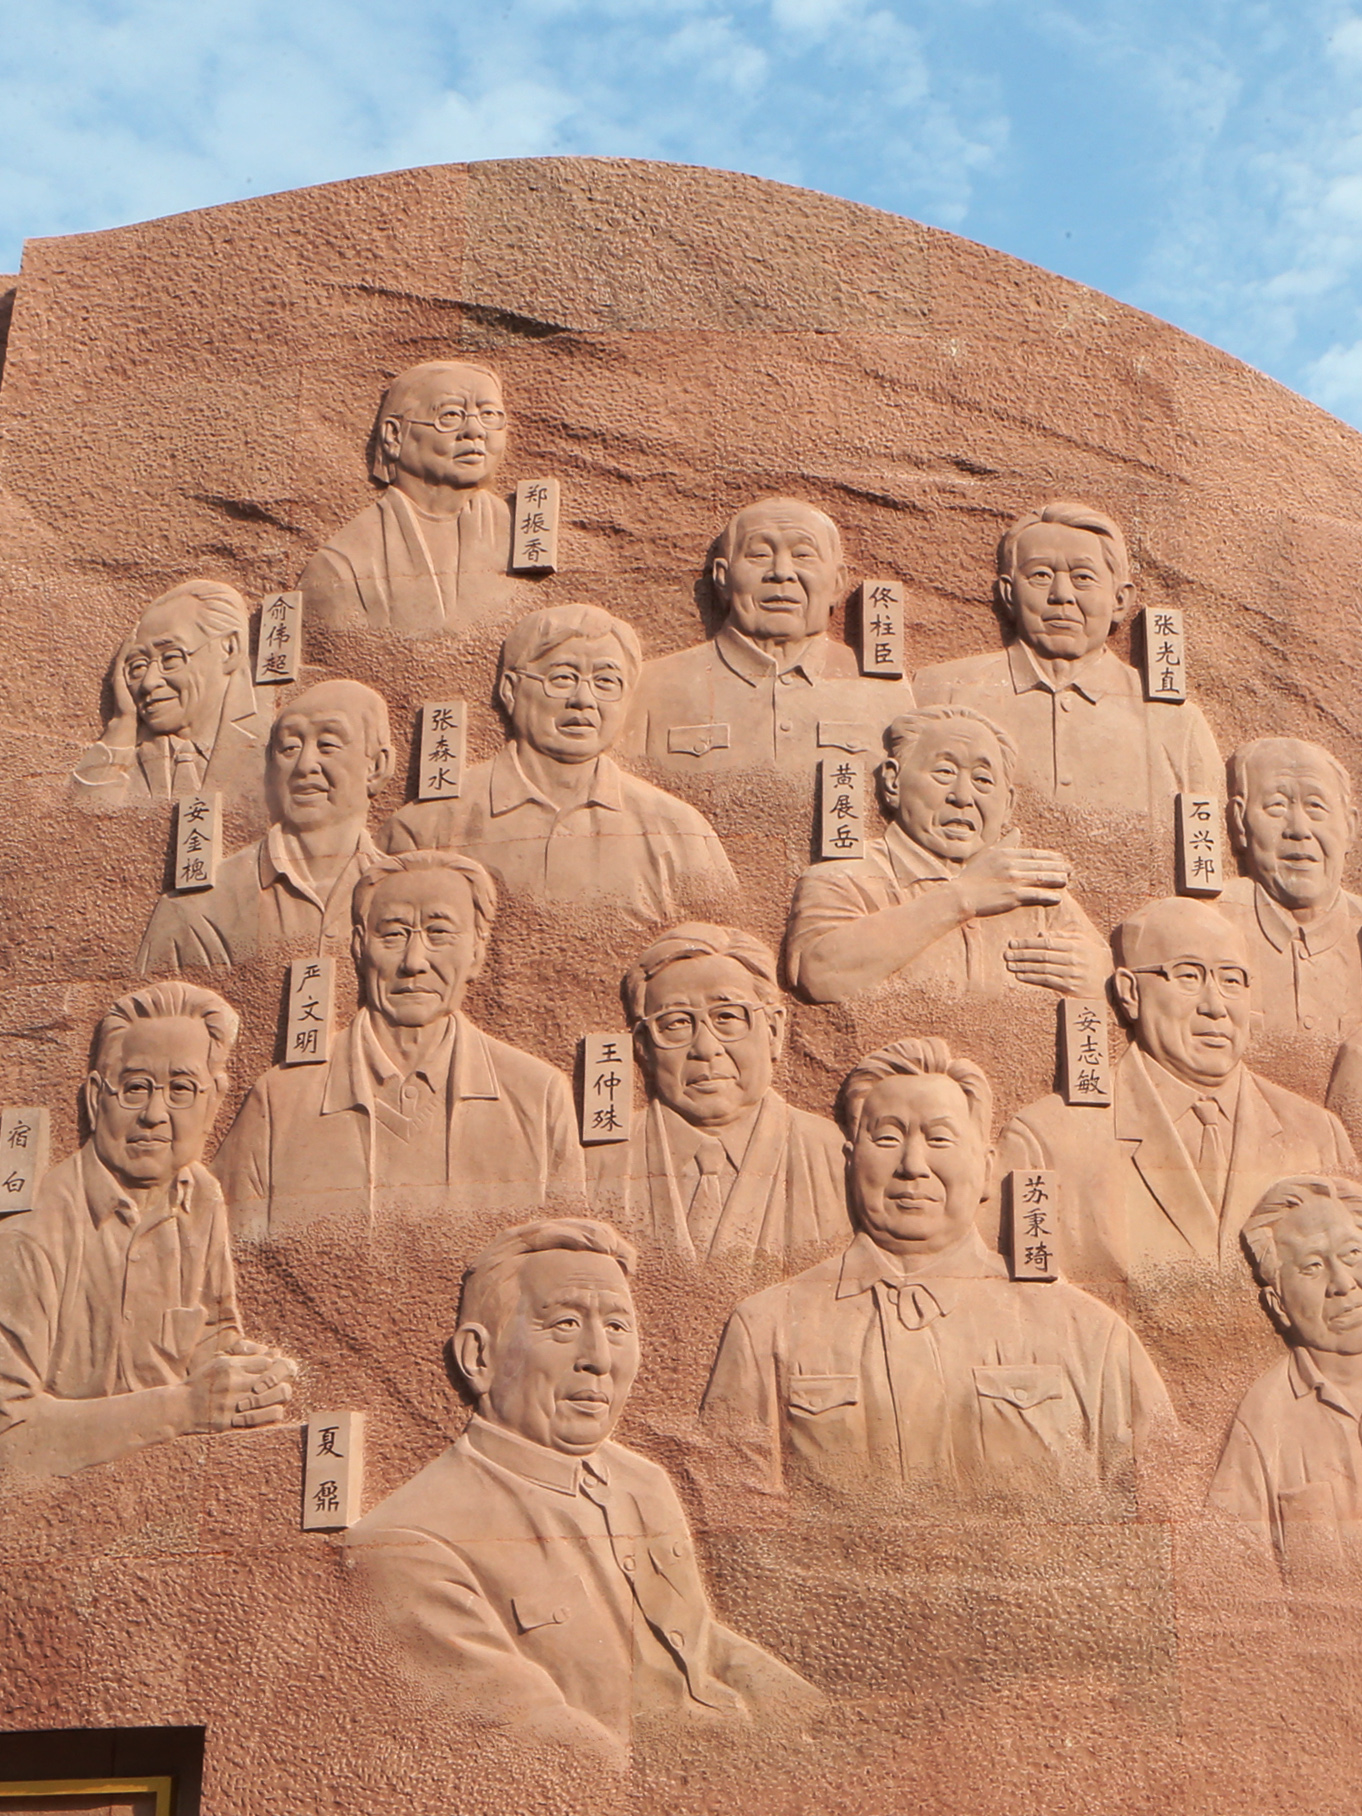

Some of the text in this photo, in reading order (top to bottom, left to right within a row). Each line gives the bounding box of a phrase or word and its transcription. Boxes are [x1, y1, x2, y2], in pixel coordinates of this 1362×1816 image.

[521, 484, 550, 563] 郑振香
[262, 596, 294, 676] 俞伟超
[869, 586, 898, 664] 佟柱臣
[1154, 614, 1180, 693] 张光直
[428, 709, 458, 790] 张森水
[180, 797, 211, 882] 安金槐
[829, 763, 859, 849] 黄展岳
[1189, 801, 1215, 883] 石兴邦
[293, 964, 324, 1053] 严文明
[591, 1042, 623, 1132] 王仲殊
[1073, 1007, 1107, 1095] 安志敏
[2, 1120, 31, 1193] 宿白
[1023, 1175, 1053, 1272] 苏秉琦
